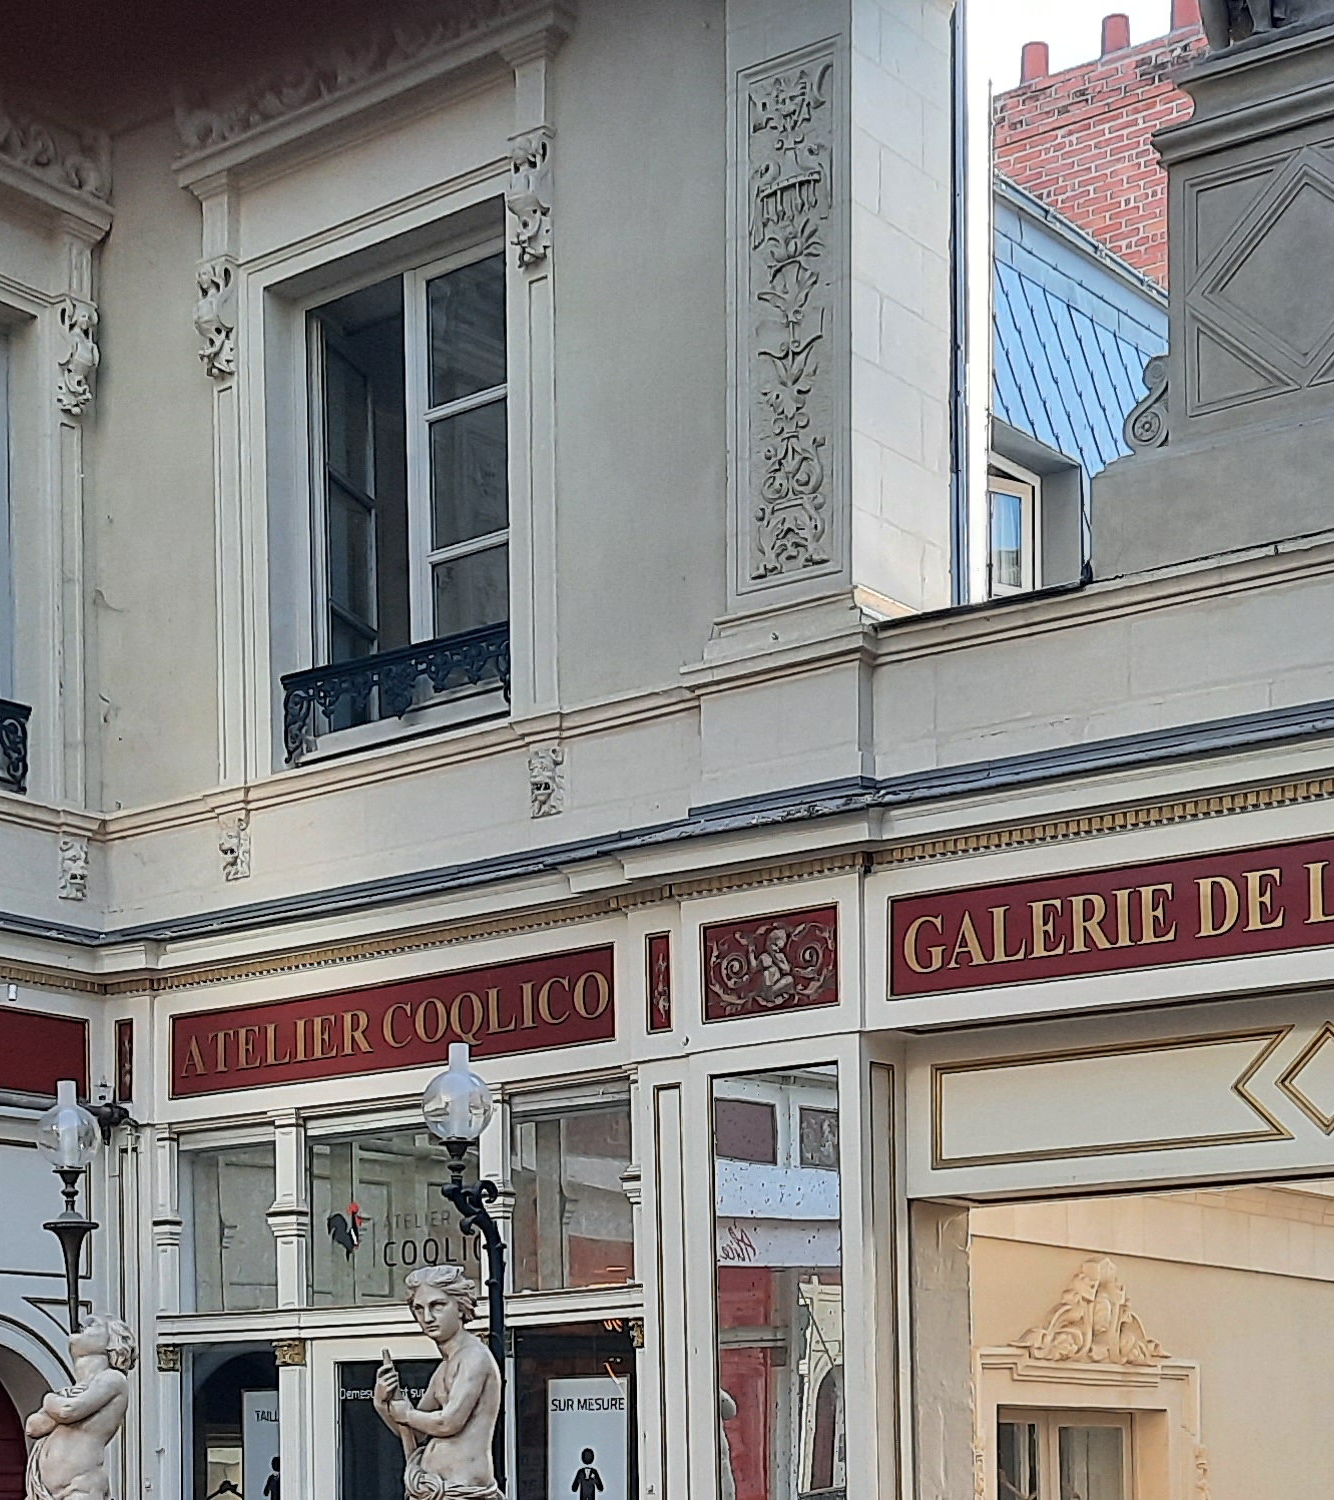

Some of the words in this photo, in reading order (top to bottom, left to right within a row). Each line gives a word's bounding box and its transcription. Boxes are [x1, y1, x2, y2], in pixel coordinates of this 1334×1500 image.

[902, 882, 1177, 975] GALERIE
[1195, 868, 1286, 940] DE
[180, 1009, 374, 1079] ATELIER
[382, 970, 610, 1048] COQLICO
[384, 1210, 450, 1230] ATELIER
[384, 1236, 480, 1267] COQLI
[551, 1399, 574, 1412] SUR
[578, 1398, 625, 1411] MESURE
